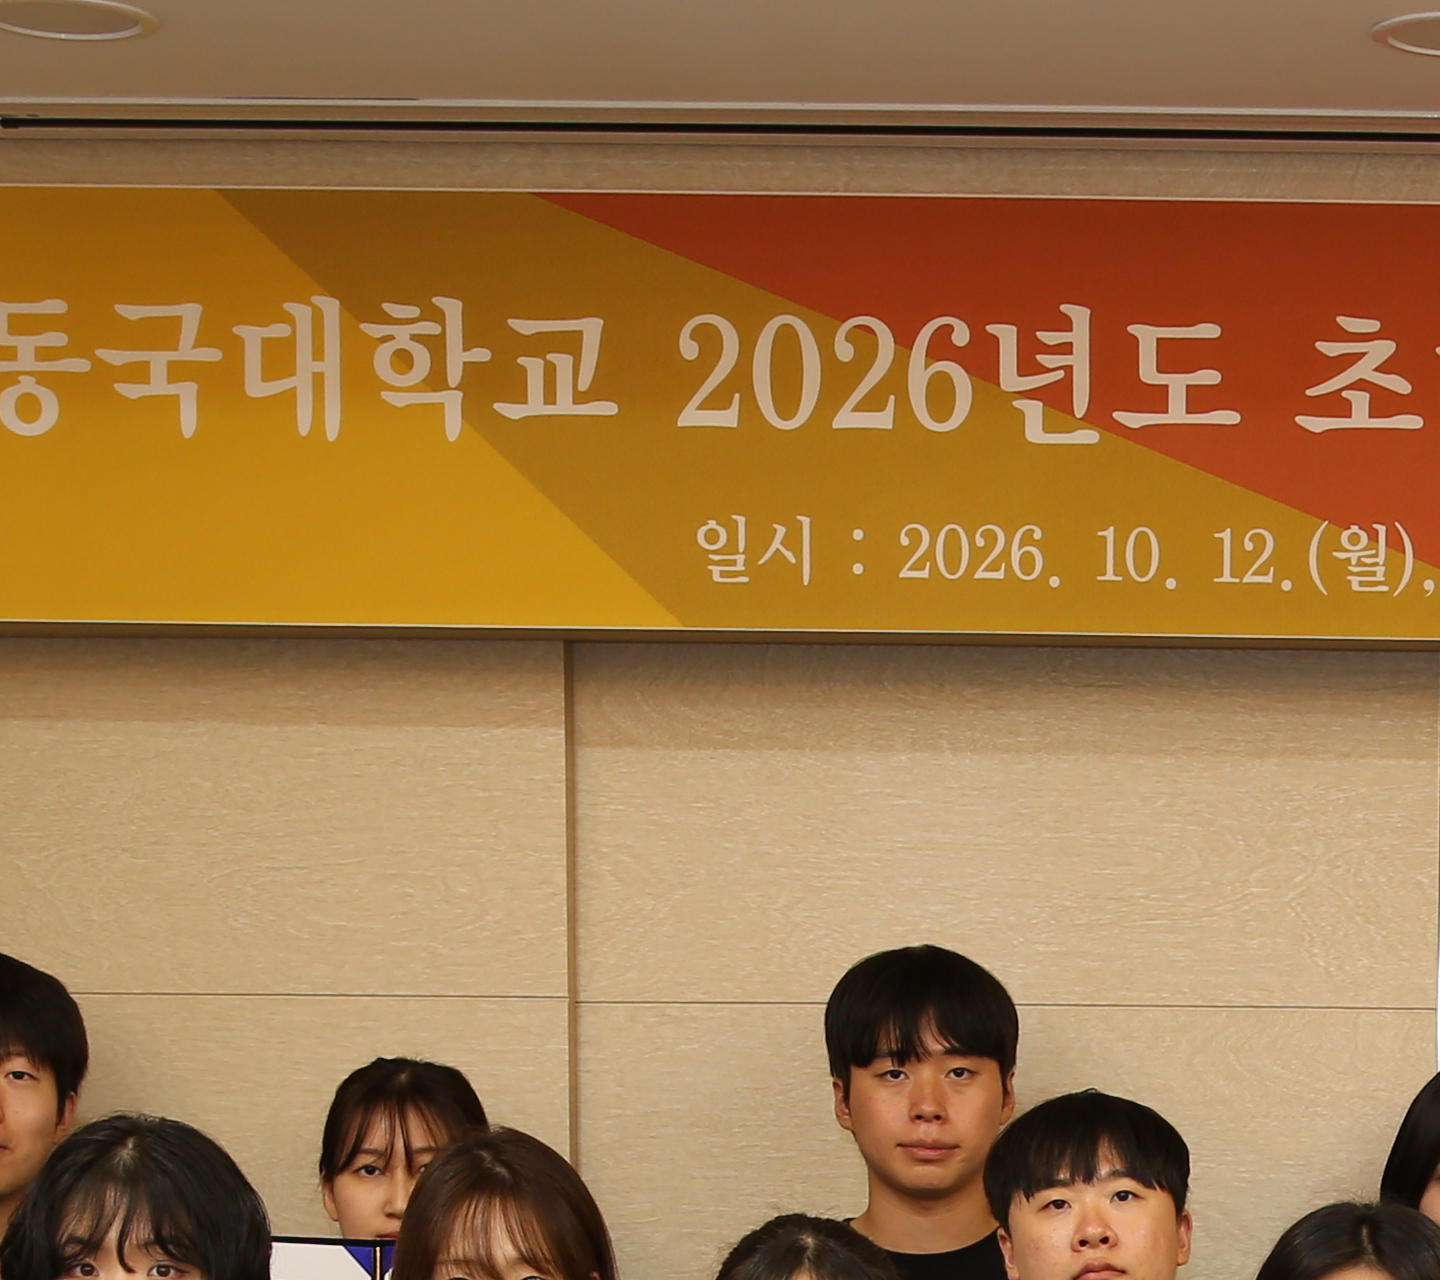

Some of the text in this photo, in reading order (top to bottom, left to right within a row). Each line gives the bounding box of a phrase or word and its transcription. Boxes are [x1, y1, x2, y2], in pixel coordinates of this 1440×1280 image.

[677, 304, 1241, 444] 2026년도
[697, 515, 810, 585] 일시
[853, 529, 863, 574] :
[899, 524, 1060, 587] 2026.
[1097, 527, 1176, 589] 10.
[1214, 521, 1435, 596] 12.(월),
